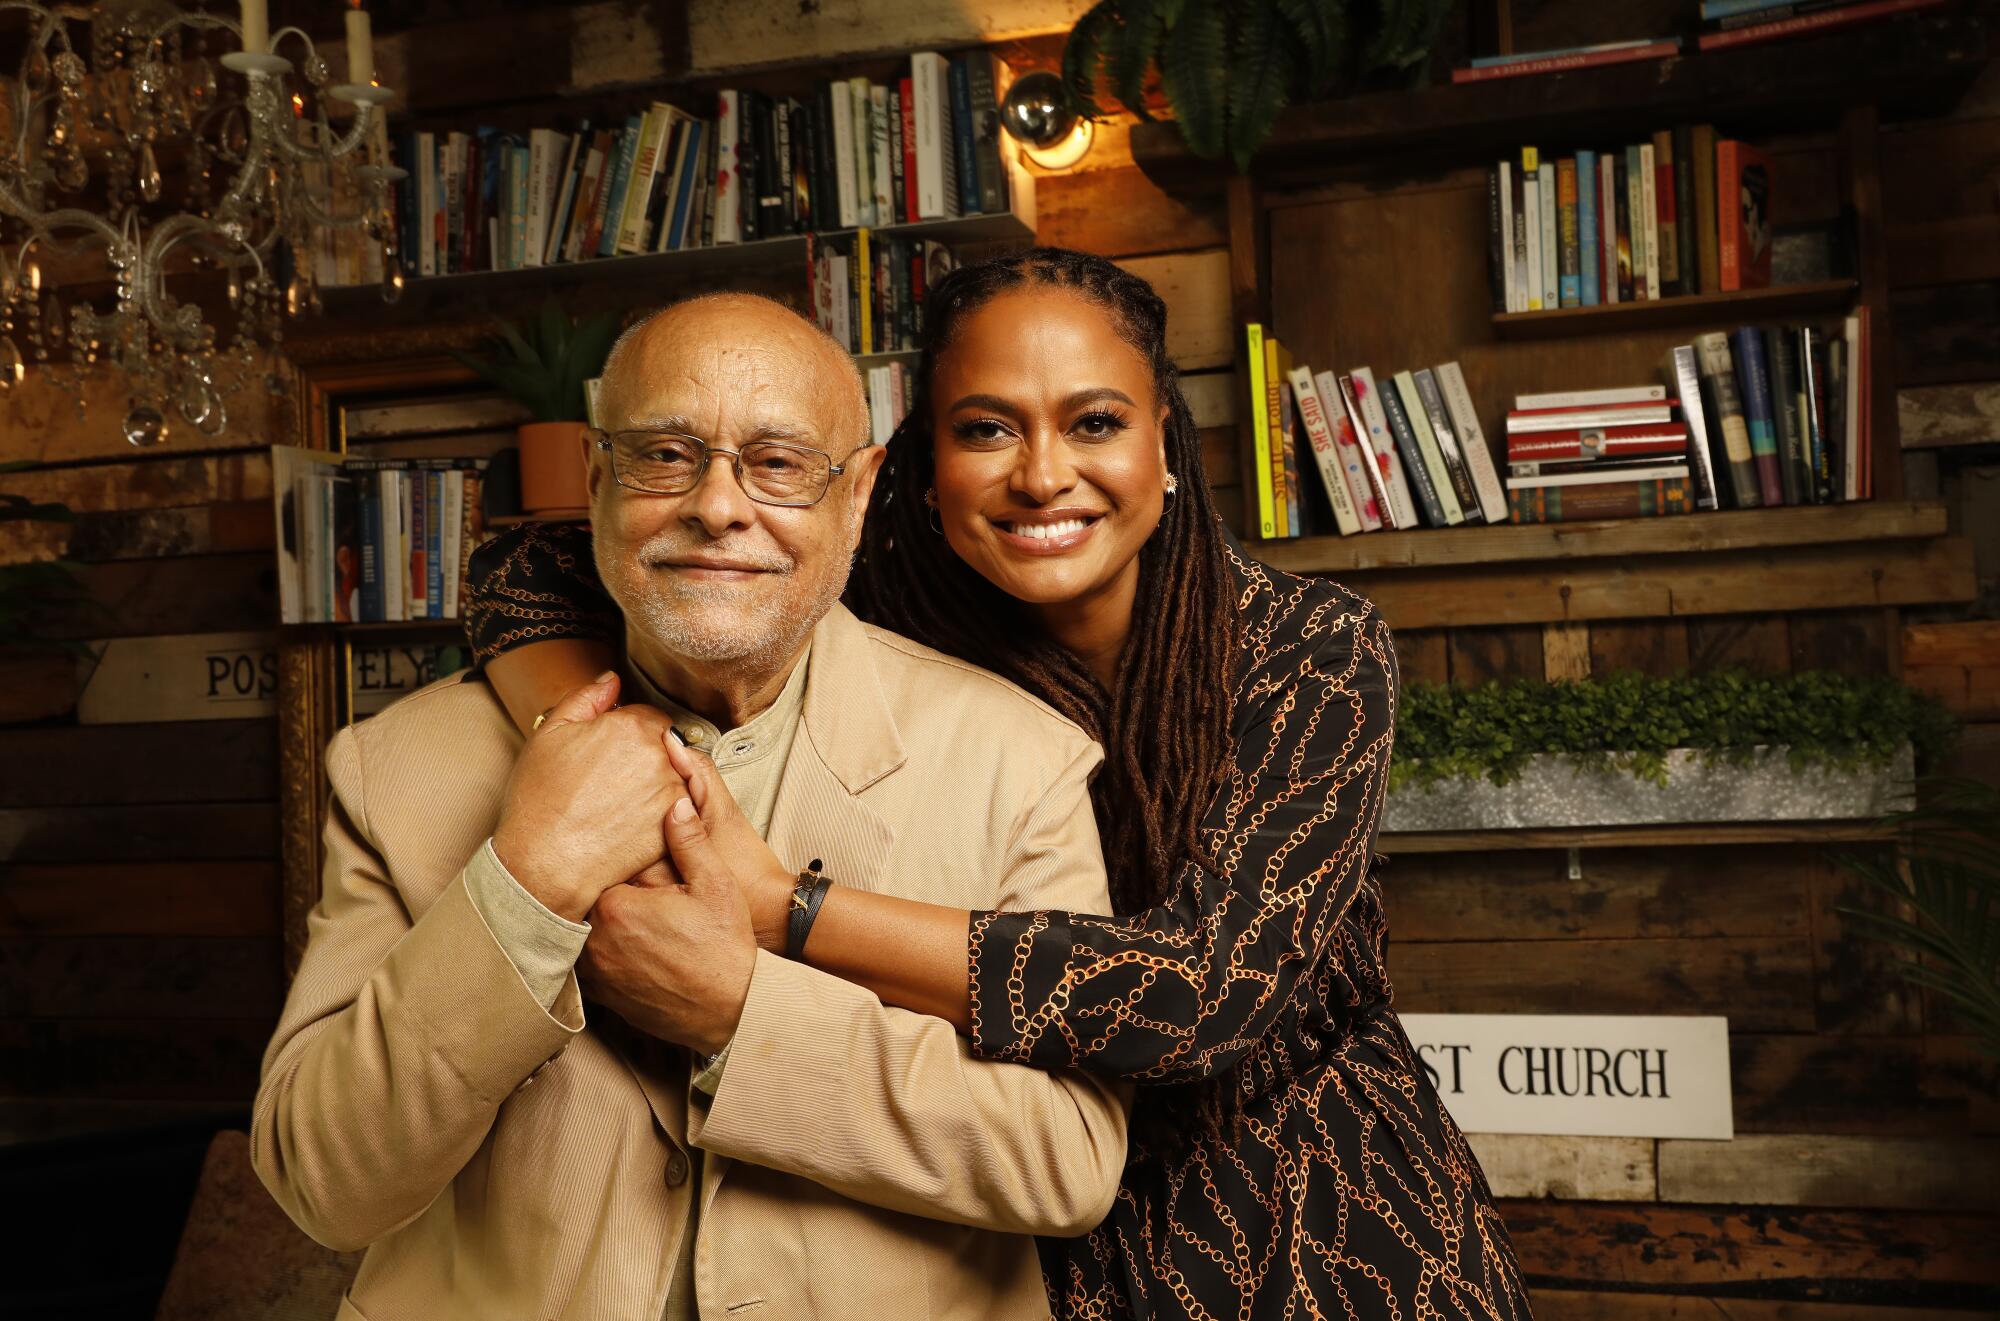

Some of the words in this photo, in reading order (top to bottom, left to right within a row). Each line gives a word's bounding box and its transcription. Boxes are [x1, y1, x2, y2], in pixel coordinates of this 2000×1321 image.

[1299, 395, 1322, 426] SAID
[1384, 391, 1410, 440] COMMON
[1310, 427, 1331, 453] SHE
[1498, 1046, 1671, 1098] CHURCH
